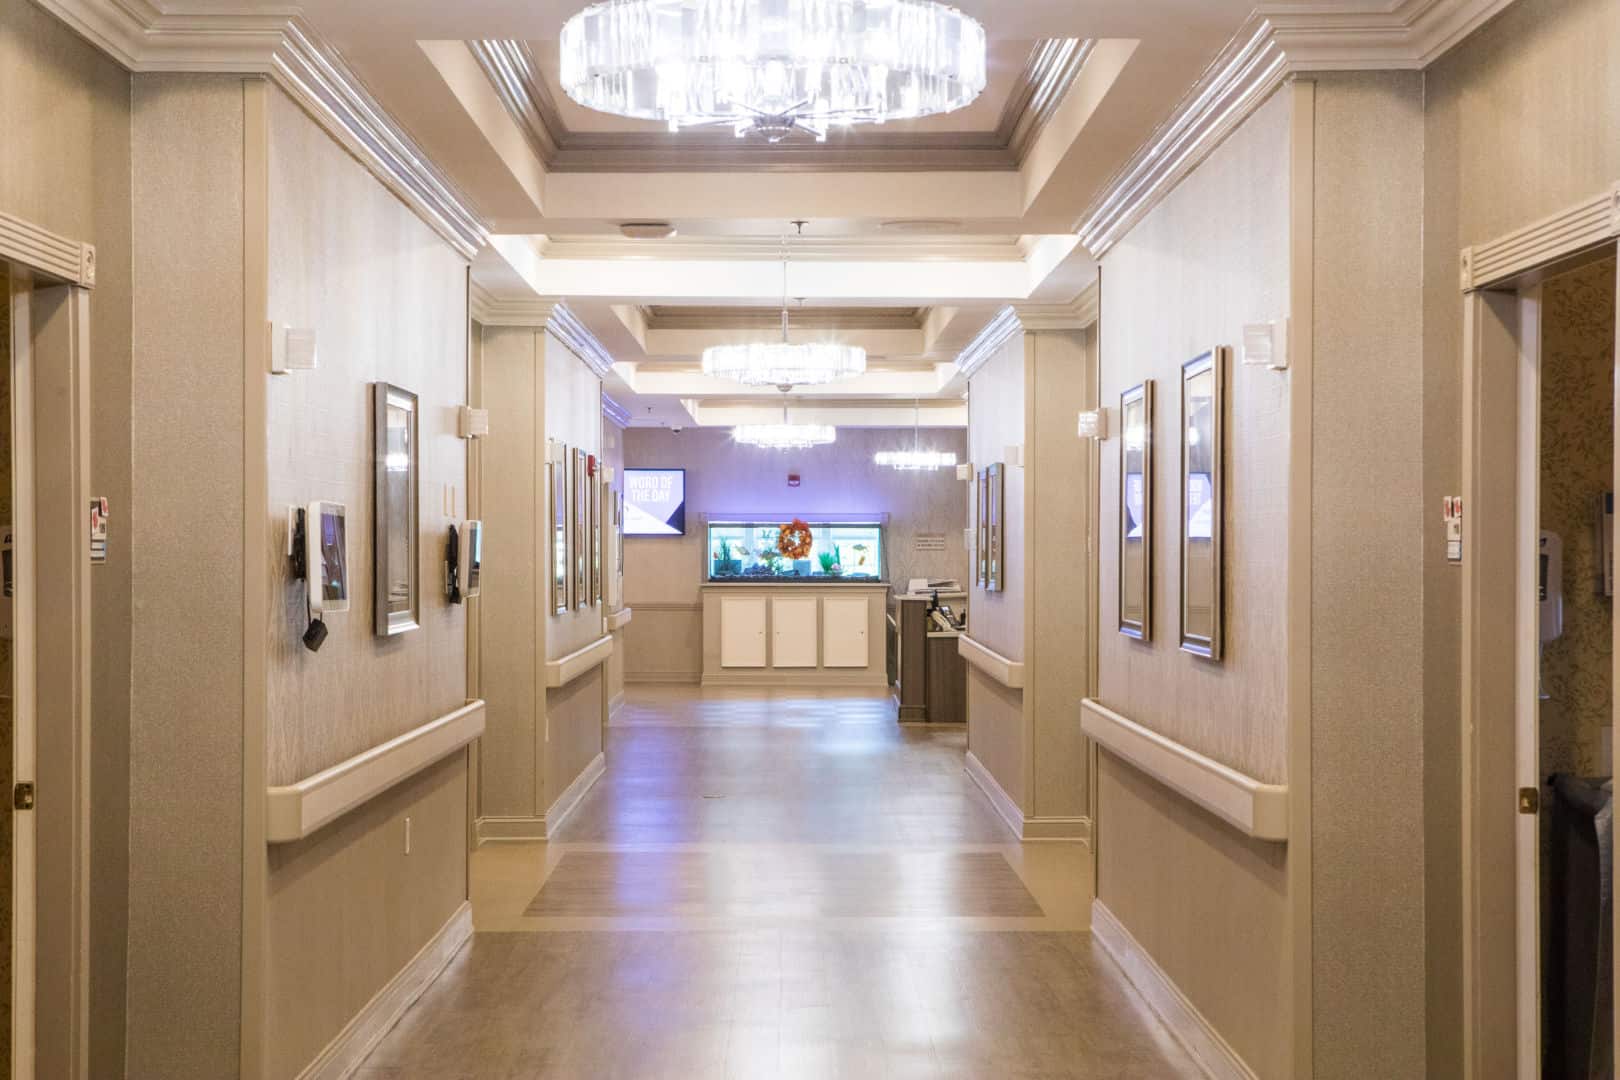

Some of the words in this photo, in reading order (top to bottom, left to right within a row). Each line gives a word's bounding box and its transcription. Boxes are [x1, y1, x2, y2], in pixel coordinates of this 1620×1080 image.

[629, 476, 658, 489] WORD
[660, 476, 673, 489] OF
[631, 489, 651, 503] THE
[652, 489, 671, 503] DAY
